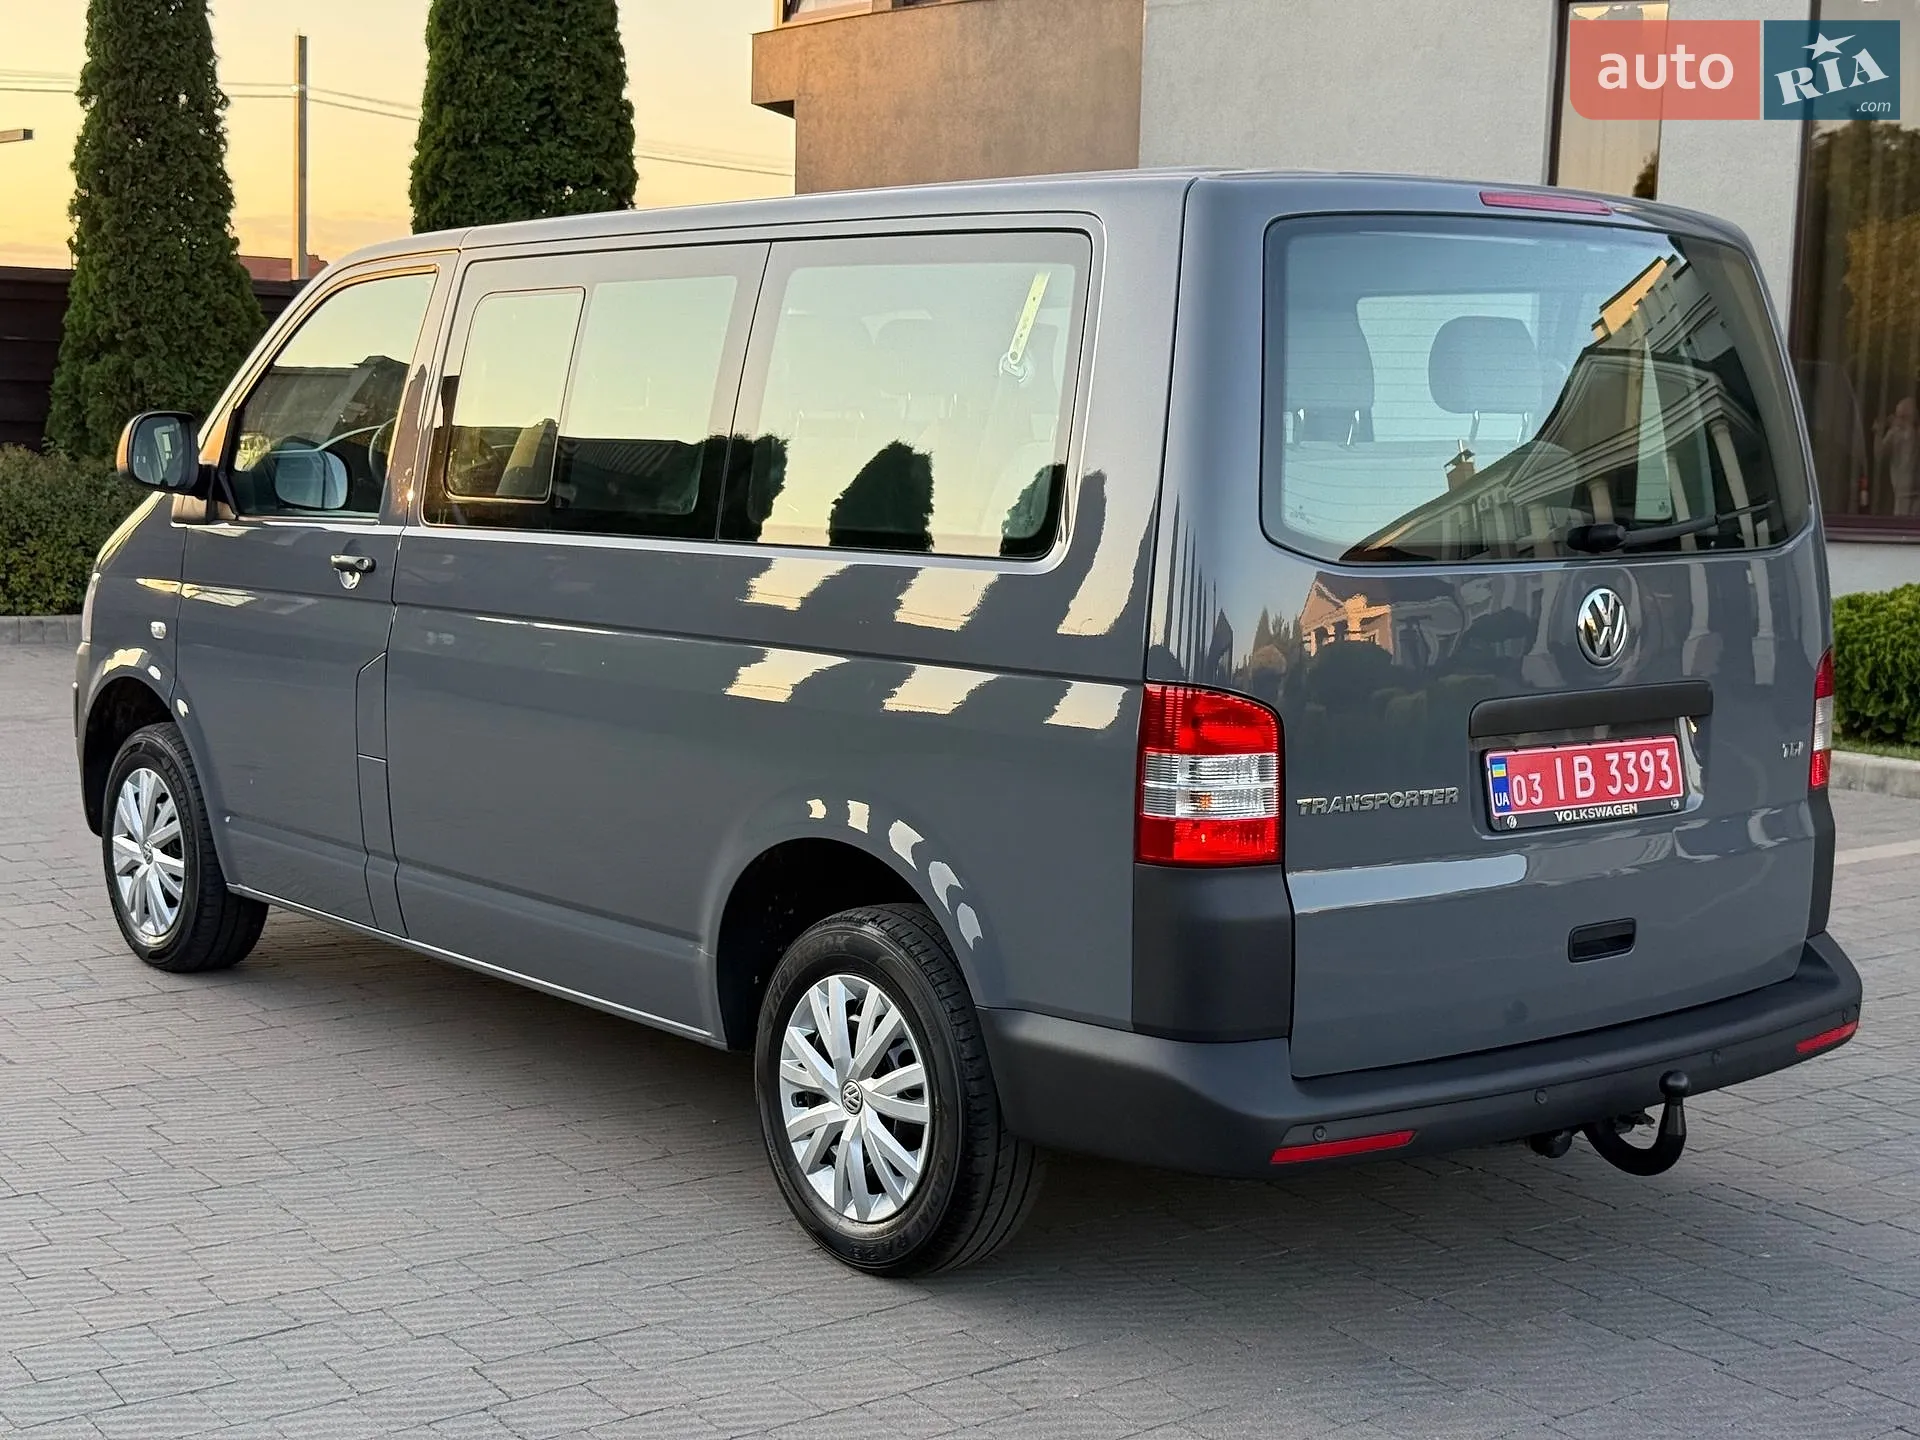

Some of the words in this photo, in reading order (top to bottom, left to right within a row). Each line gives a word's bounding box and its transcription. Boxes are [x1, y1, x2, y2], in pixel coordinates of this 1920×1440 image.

[1512, 773, 1543, 807] 03
[1554, 755, 1595, 801] IB
[1604, 748, 1673, 796] 3393
[1296, 786, 1459, 816] TRANSPORTER
[1495, 791, 1510, 807] UA
[1554, 802, 1638, 823] VOLKSWAGEN
